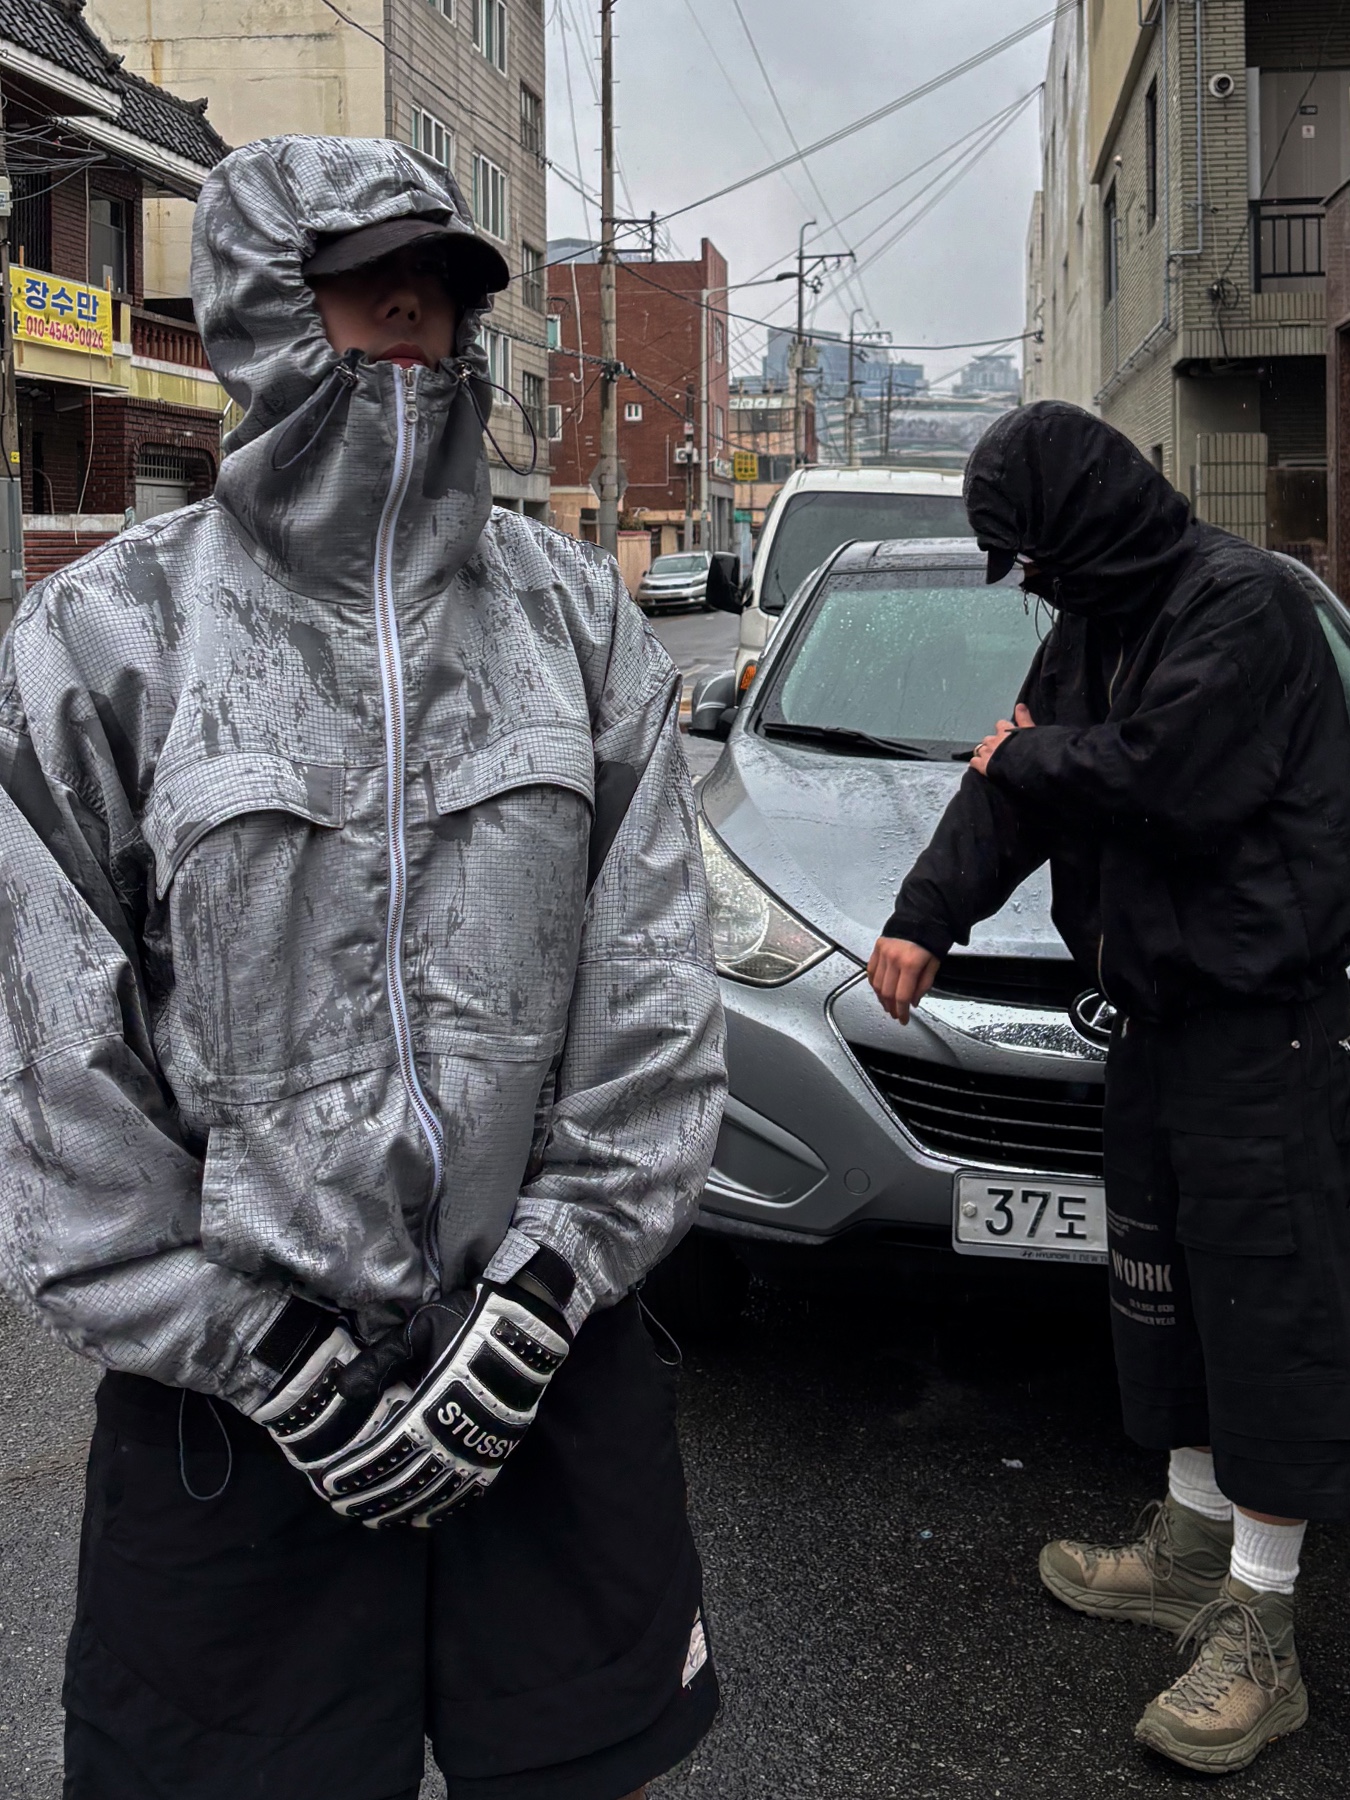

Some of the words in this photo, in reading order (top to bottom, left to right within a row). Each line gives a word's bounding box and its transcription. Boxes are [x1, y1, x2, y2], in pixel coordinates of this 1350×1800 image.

[25, 278, 99, 322] 장수만
[26, 315, 104, 349] 010-4543-0026
[985, 1188, 1087, 1240] 37도
[1035, 1251, 1070, 1260] HYUNDAI
[1111, 1249, 1173, 1292] WORK
[437, 1401, 520, 1459] STUSSY
